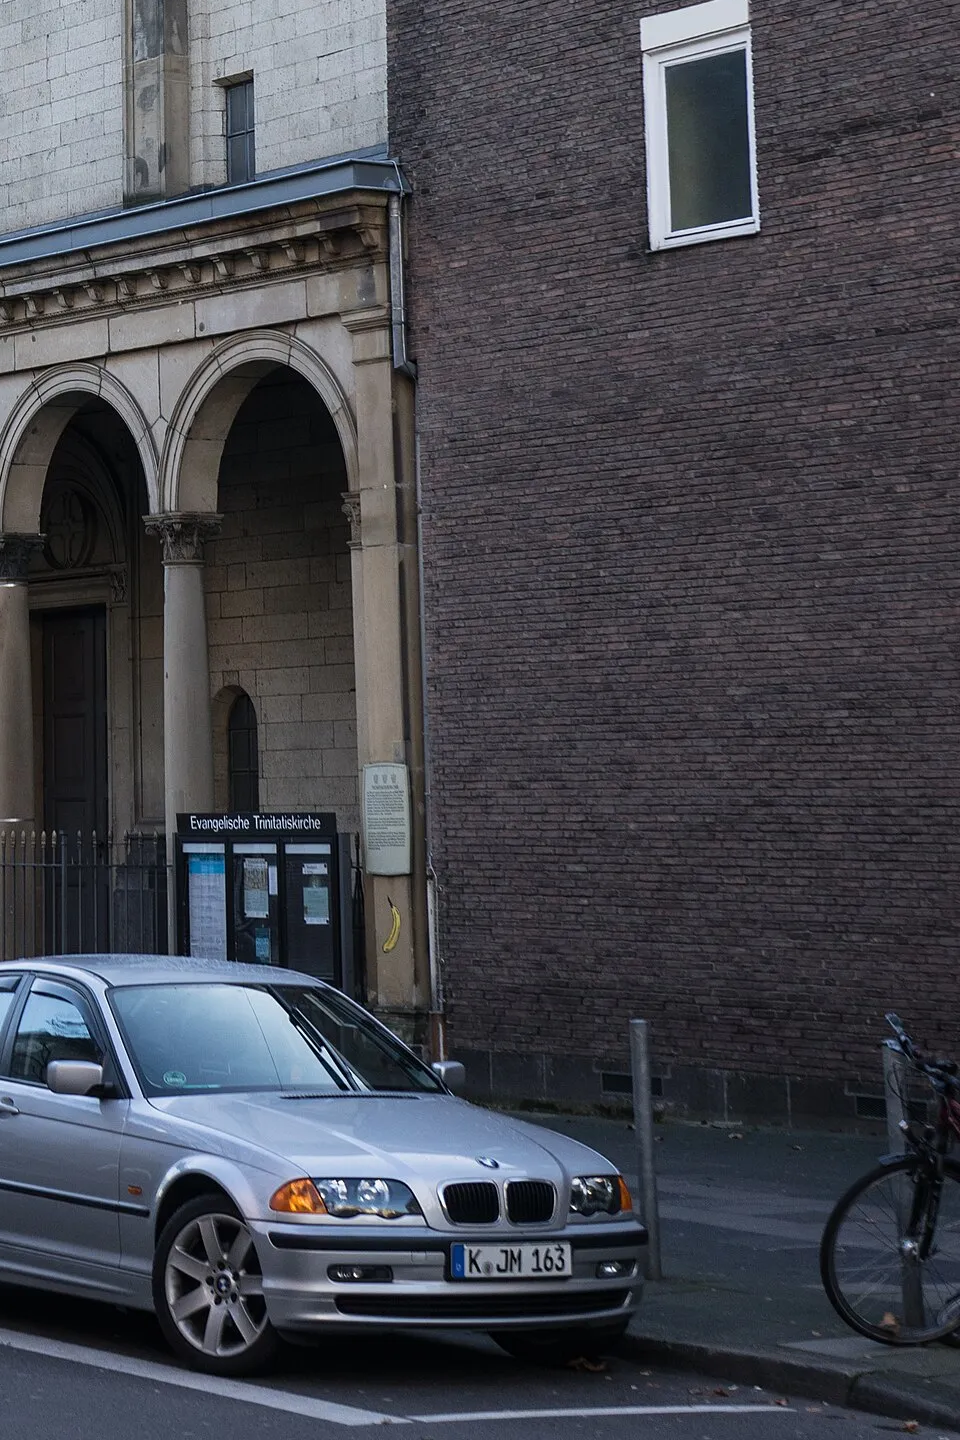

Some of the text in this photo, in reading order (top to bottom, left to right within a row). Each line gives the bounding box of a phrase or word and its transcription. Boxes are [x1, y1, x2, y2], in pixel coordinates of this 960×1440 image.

[190, 815, 321, 832] Evangelische Trinitatiskirche
[468, 1244, 565, 1273] K JM 163
